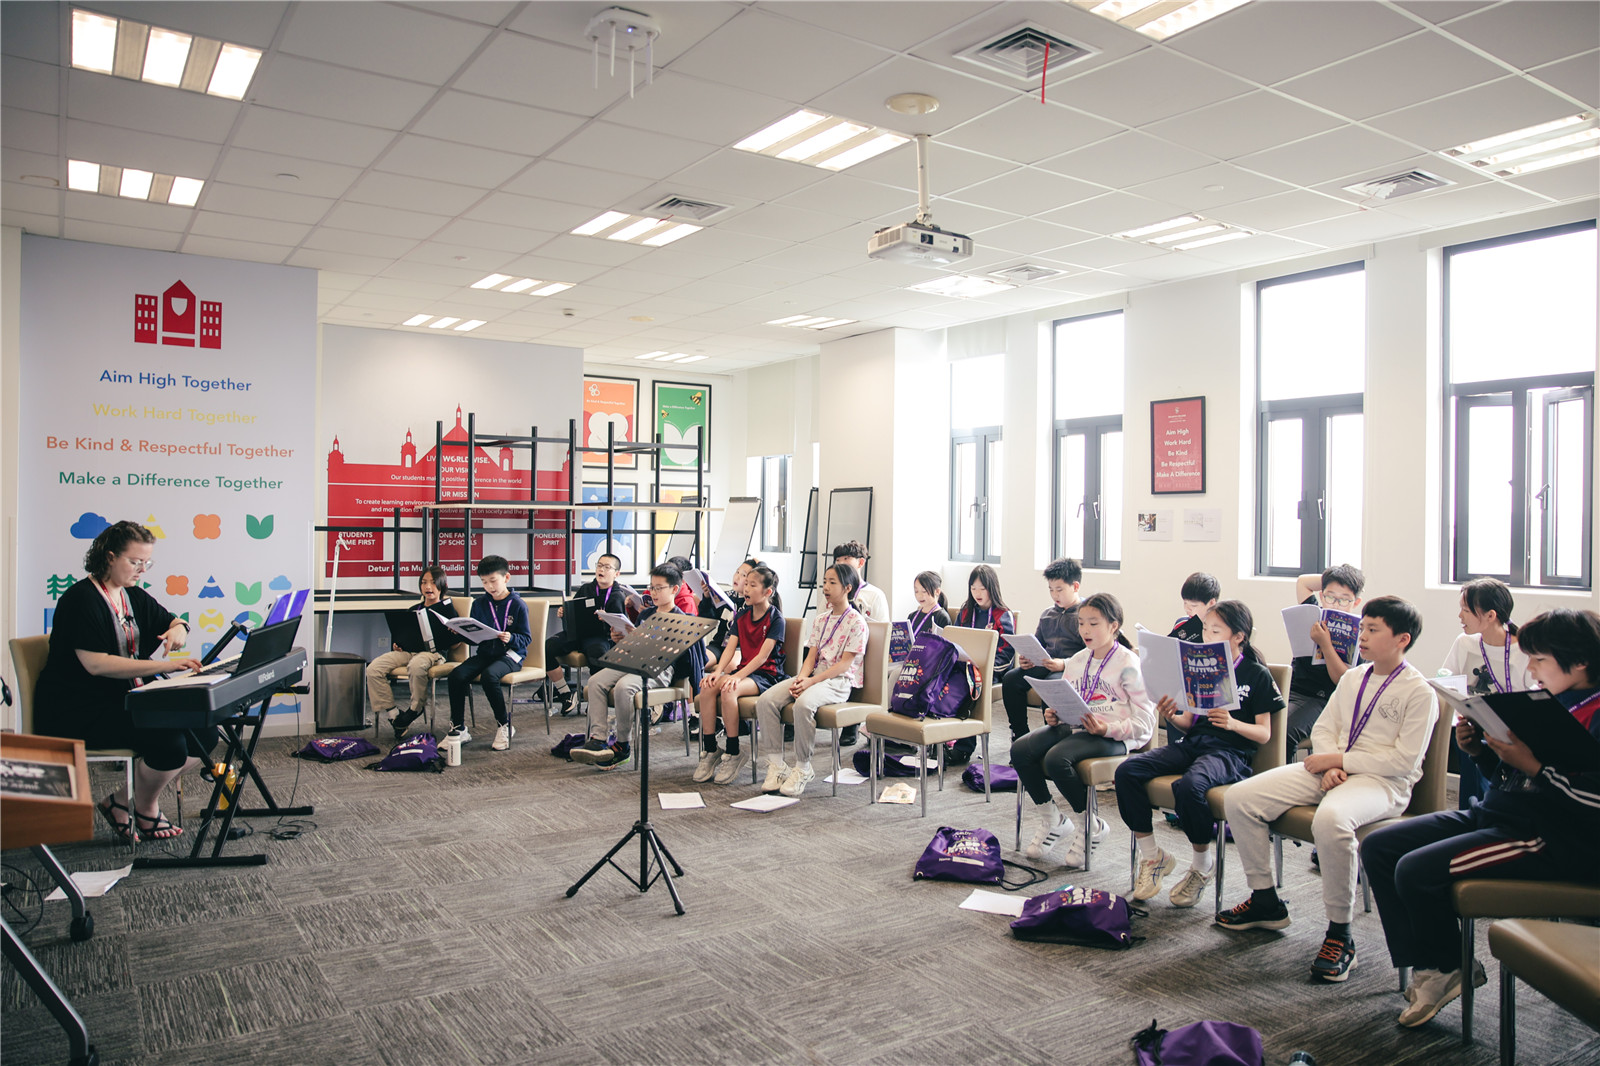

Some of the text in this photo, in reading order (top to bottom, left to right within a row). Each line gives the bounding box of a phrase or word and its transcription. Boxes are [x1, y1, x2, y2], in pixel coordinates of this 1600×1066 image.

[100, 370, 252, 392] Aim High Together
[92, 403, 258, 425] Work Hard Together
[46, 436, 294, 459] Be Kind & Respectful Together
[59, 472, 283, 492] Make a Difference Together
[1328, 620, 1352, 631] MADD
[1188, 657, 1217, 666] MADD
